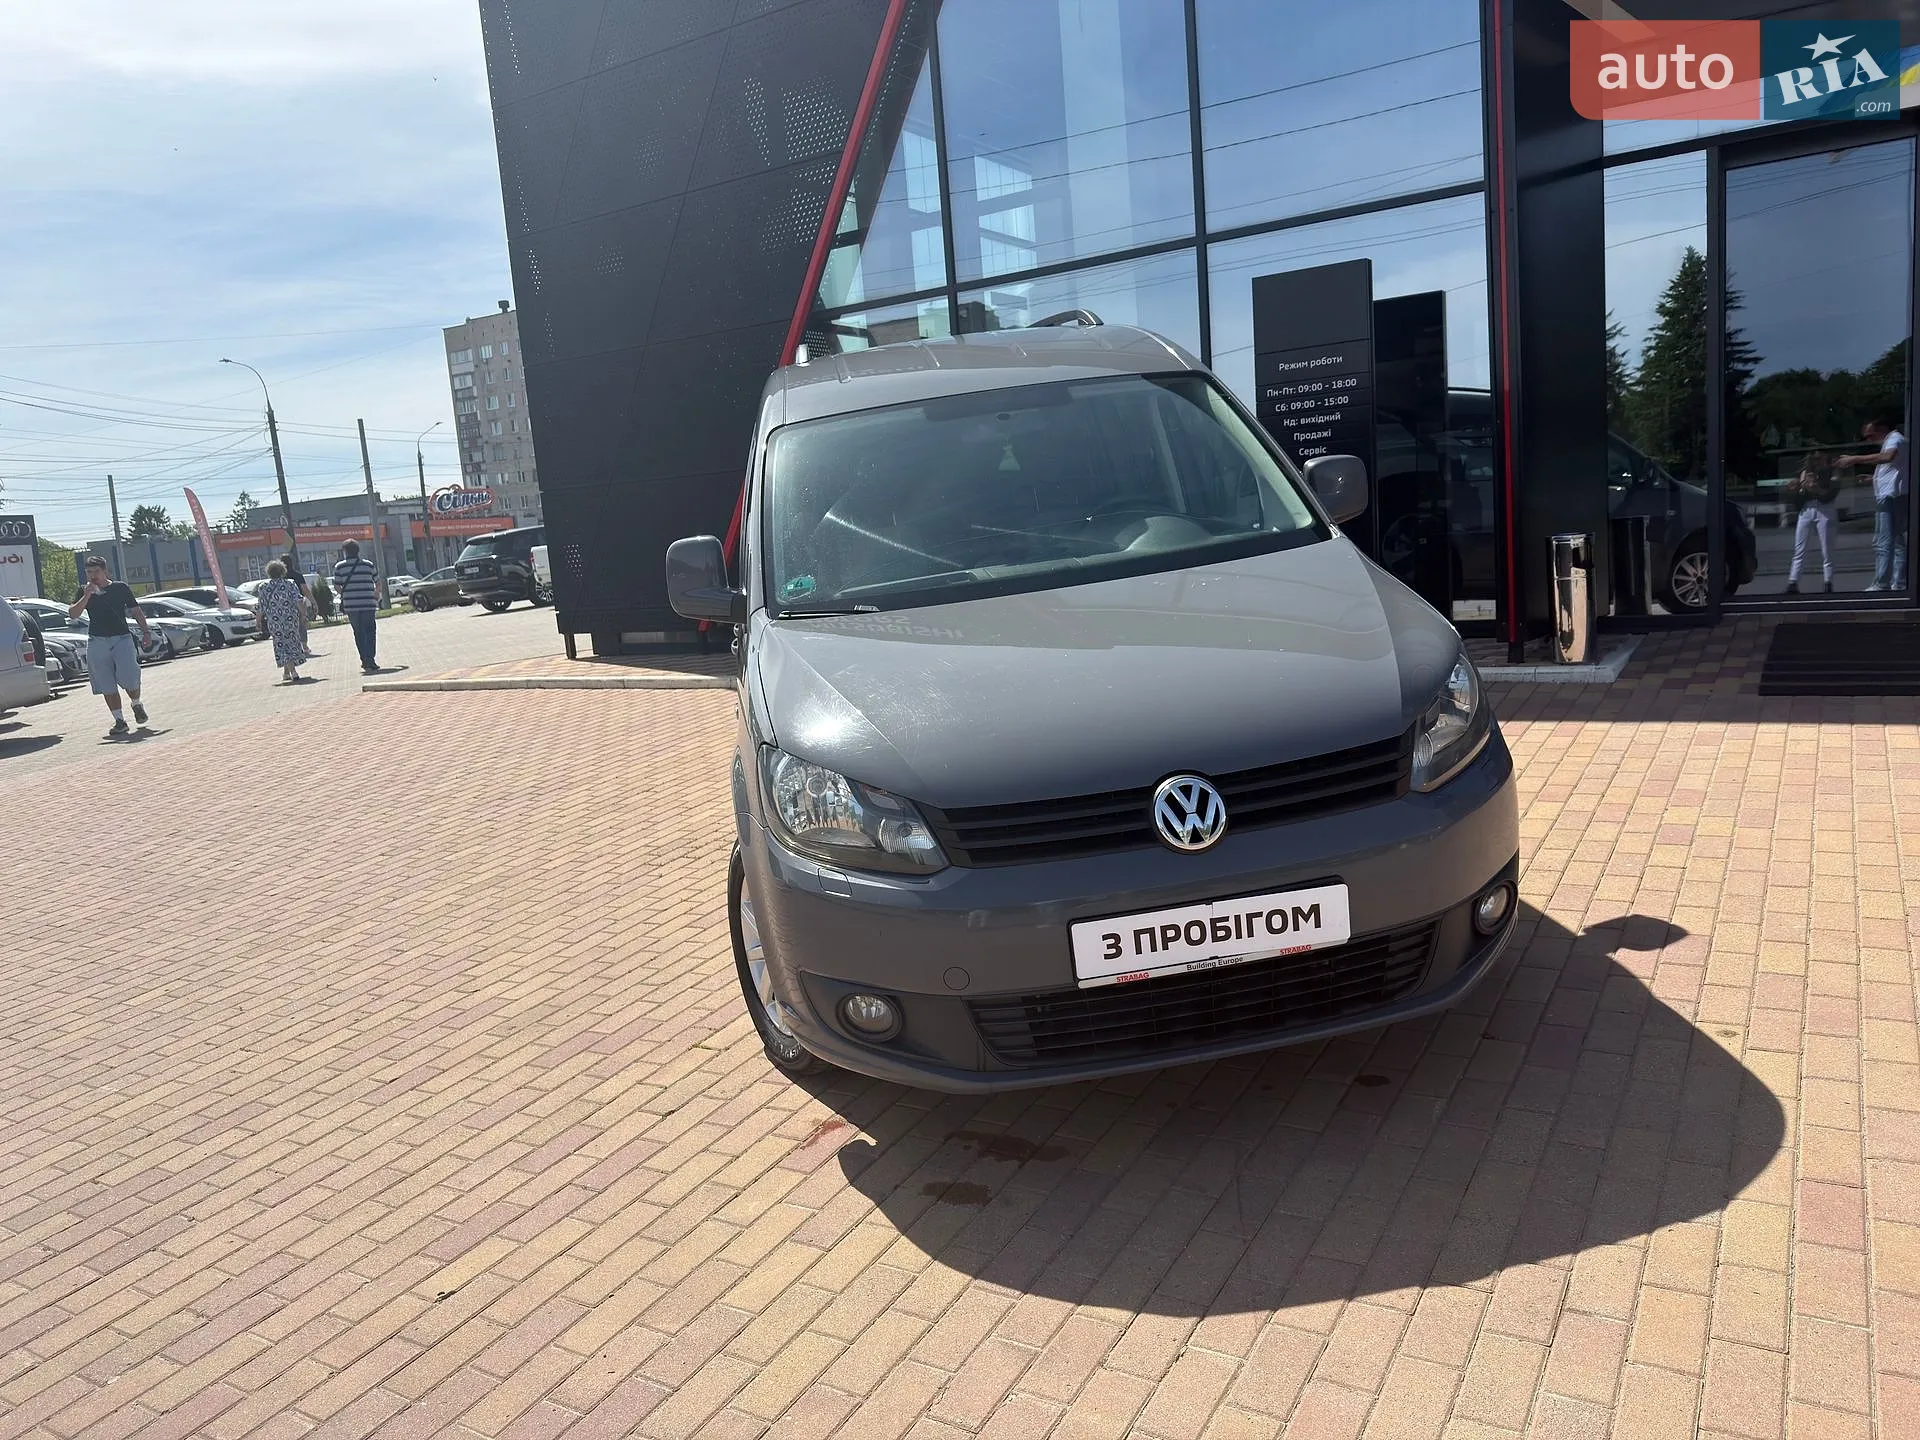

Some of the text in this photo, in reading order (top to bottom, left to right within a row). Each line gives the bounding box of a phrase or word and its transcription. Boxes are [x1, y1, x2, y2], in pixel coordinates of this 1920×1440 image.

[1279, 356, 1343, 372] Режим роботи
[1266, 387, 1297, 398] Пн-Пт:
[1298, 382, 1323, 394] 09:00
[1331, 378, 1357, 390] 18:00
[1275, 403, 1290, 412] Сб:
[1290, 400, 1315, 410] 09:00
[1324, 395, 1349, 407] 15:00
[1283, 412, 1341, 427] Нд: вихідний
[1293, 428, 1332, 441] Продажі
[1298, 445, 1328, 457] Сервіс
[1133, 903, 1322, 956] ПРОБІГОМ
[1279, 944, 1312, 955] STRABAG
[1186, 956, 1244, 972] Building Europe
[1116, 971, 1150, 983] STRABAG
